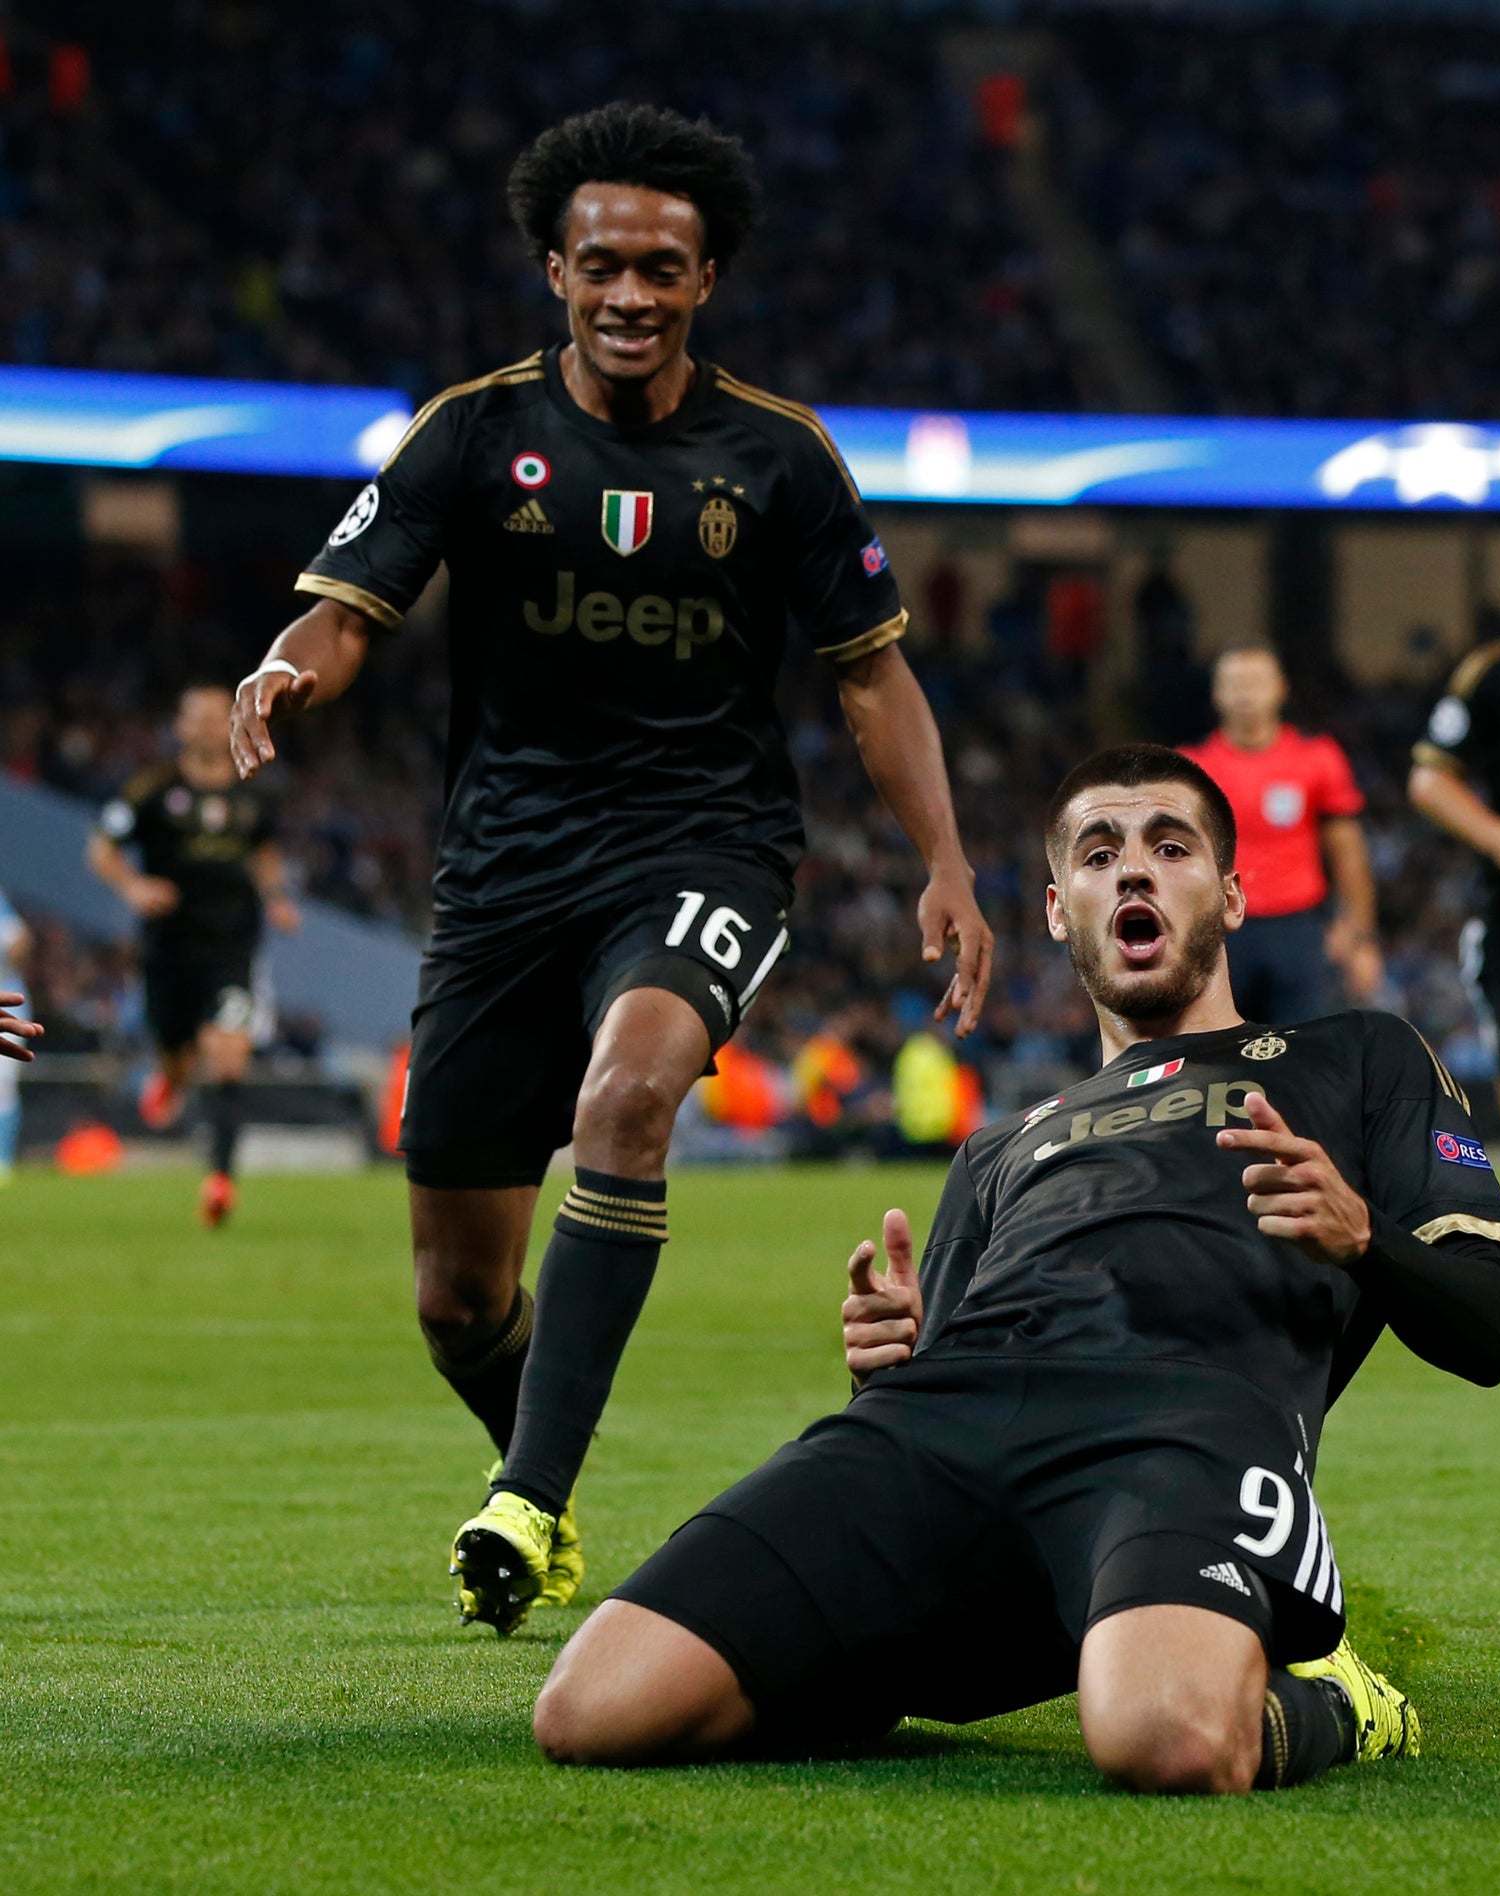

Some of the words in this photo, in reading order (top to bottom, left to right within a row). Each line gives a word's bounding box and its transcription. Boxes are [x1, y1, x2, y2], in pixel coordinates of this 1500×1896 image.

[523, 570, 724, 660] Jeep
[664, 890, 752, 970] 16
[1033, 1080, 1267, 1162] Jeep
[1233, 1466, 1295, 1558] 9
[1199, 1568, 1251, 1597] adidas
